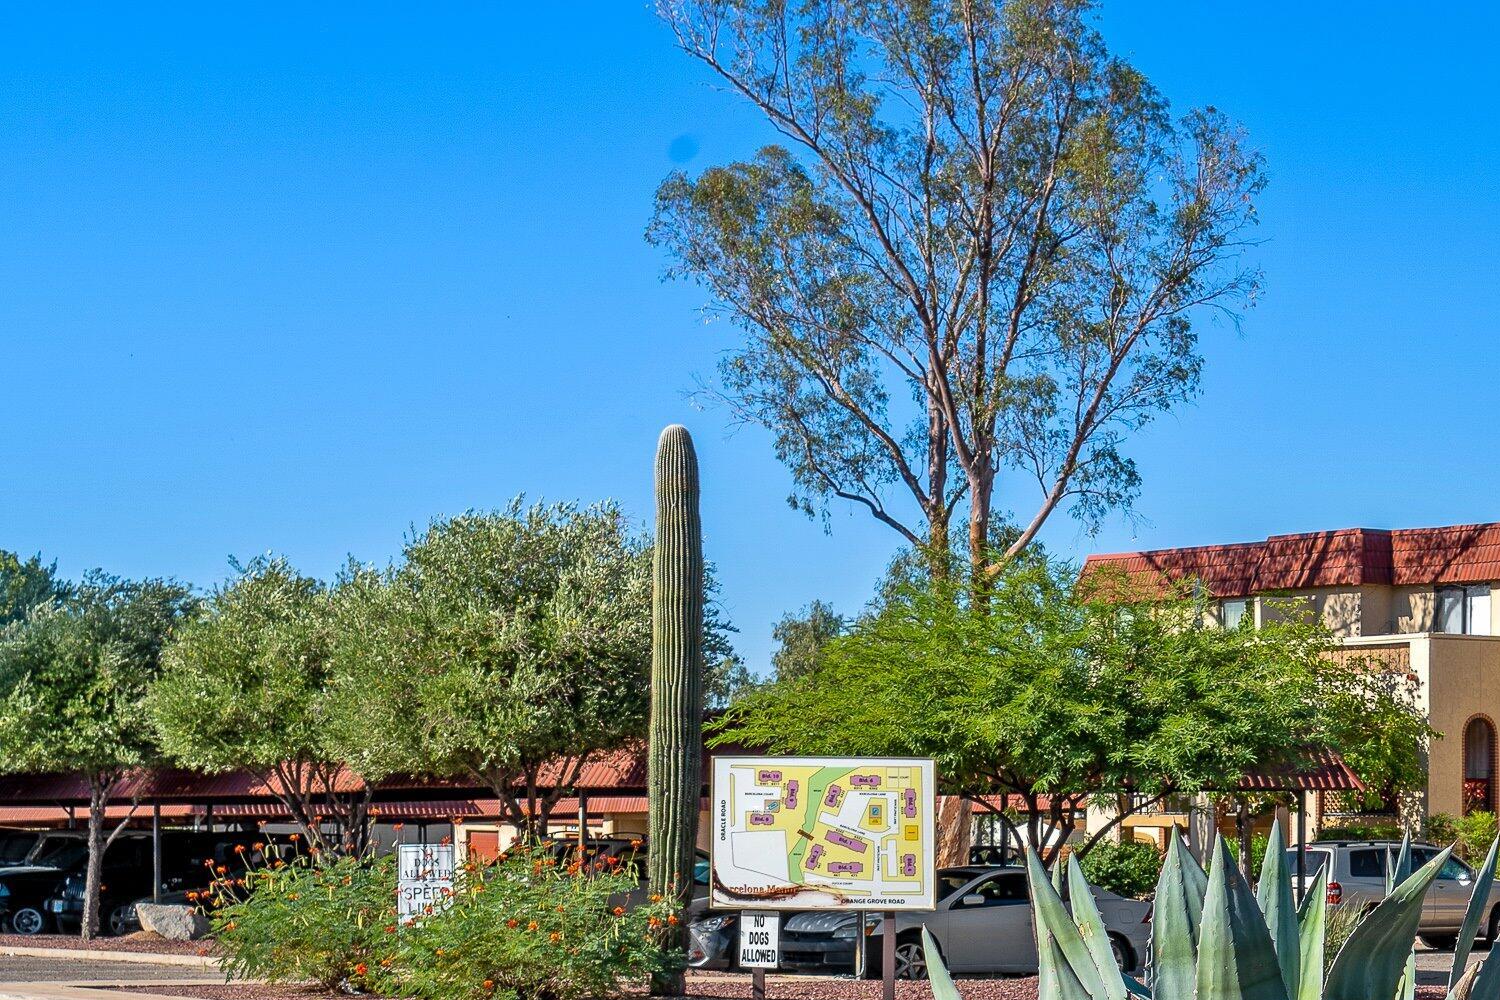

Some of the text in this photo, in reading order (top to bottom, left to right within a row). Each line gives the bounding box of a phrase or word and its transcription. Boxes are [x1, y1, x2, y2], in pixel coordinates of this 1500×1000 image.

[404, 869, 452, 879] ALLWED
[754, 914, 765, 928] NO
[749, 931, 769, 945] DOGS
[742, 949, 776, 963] ALLOWED
